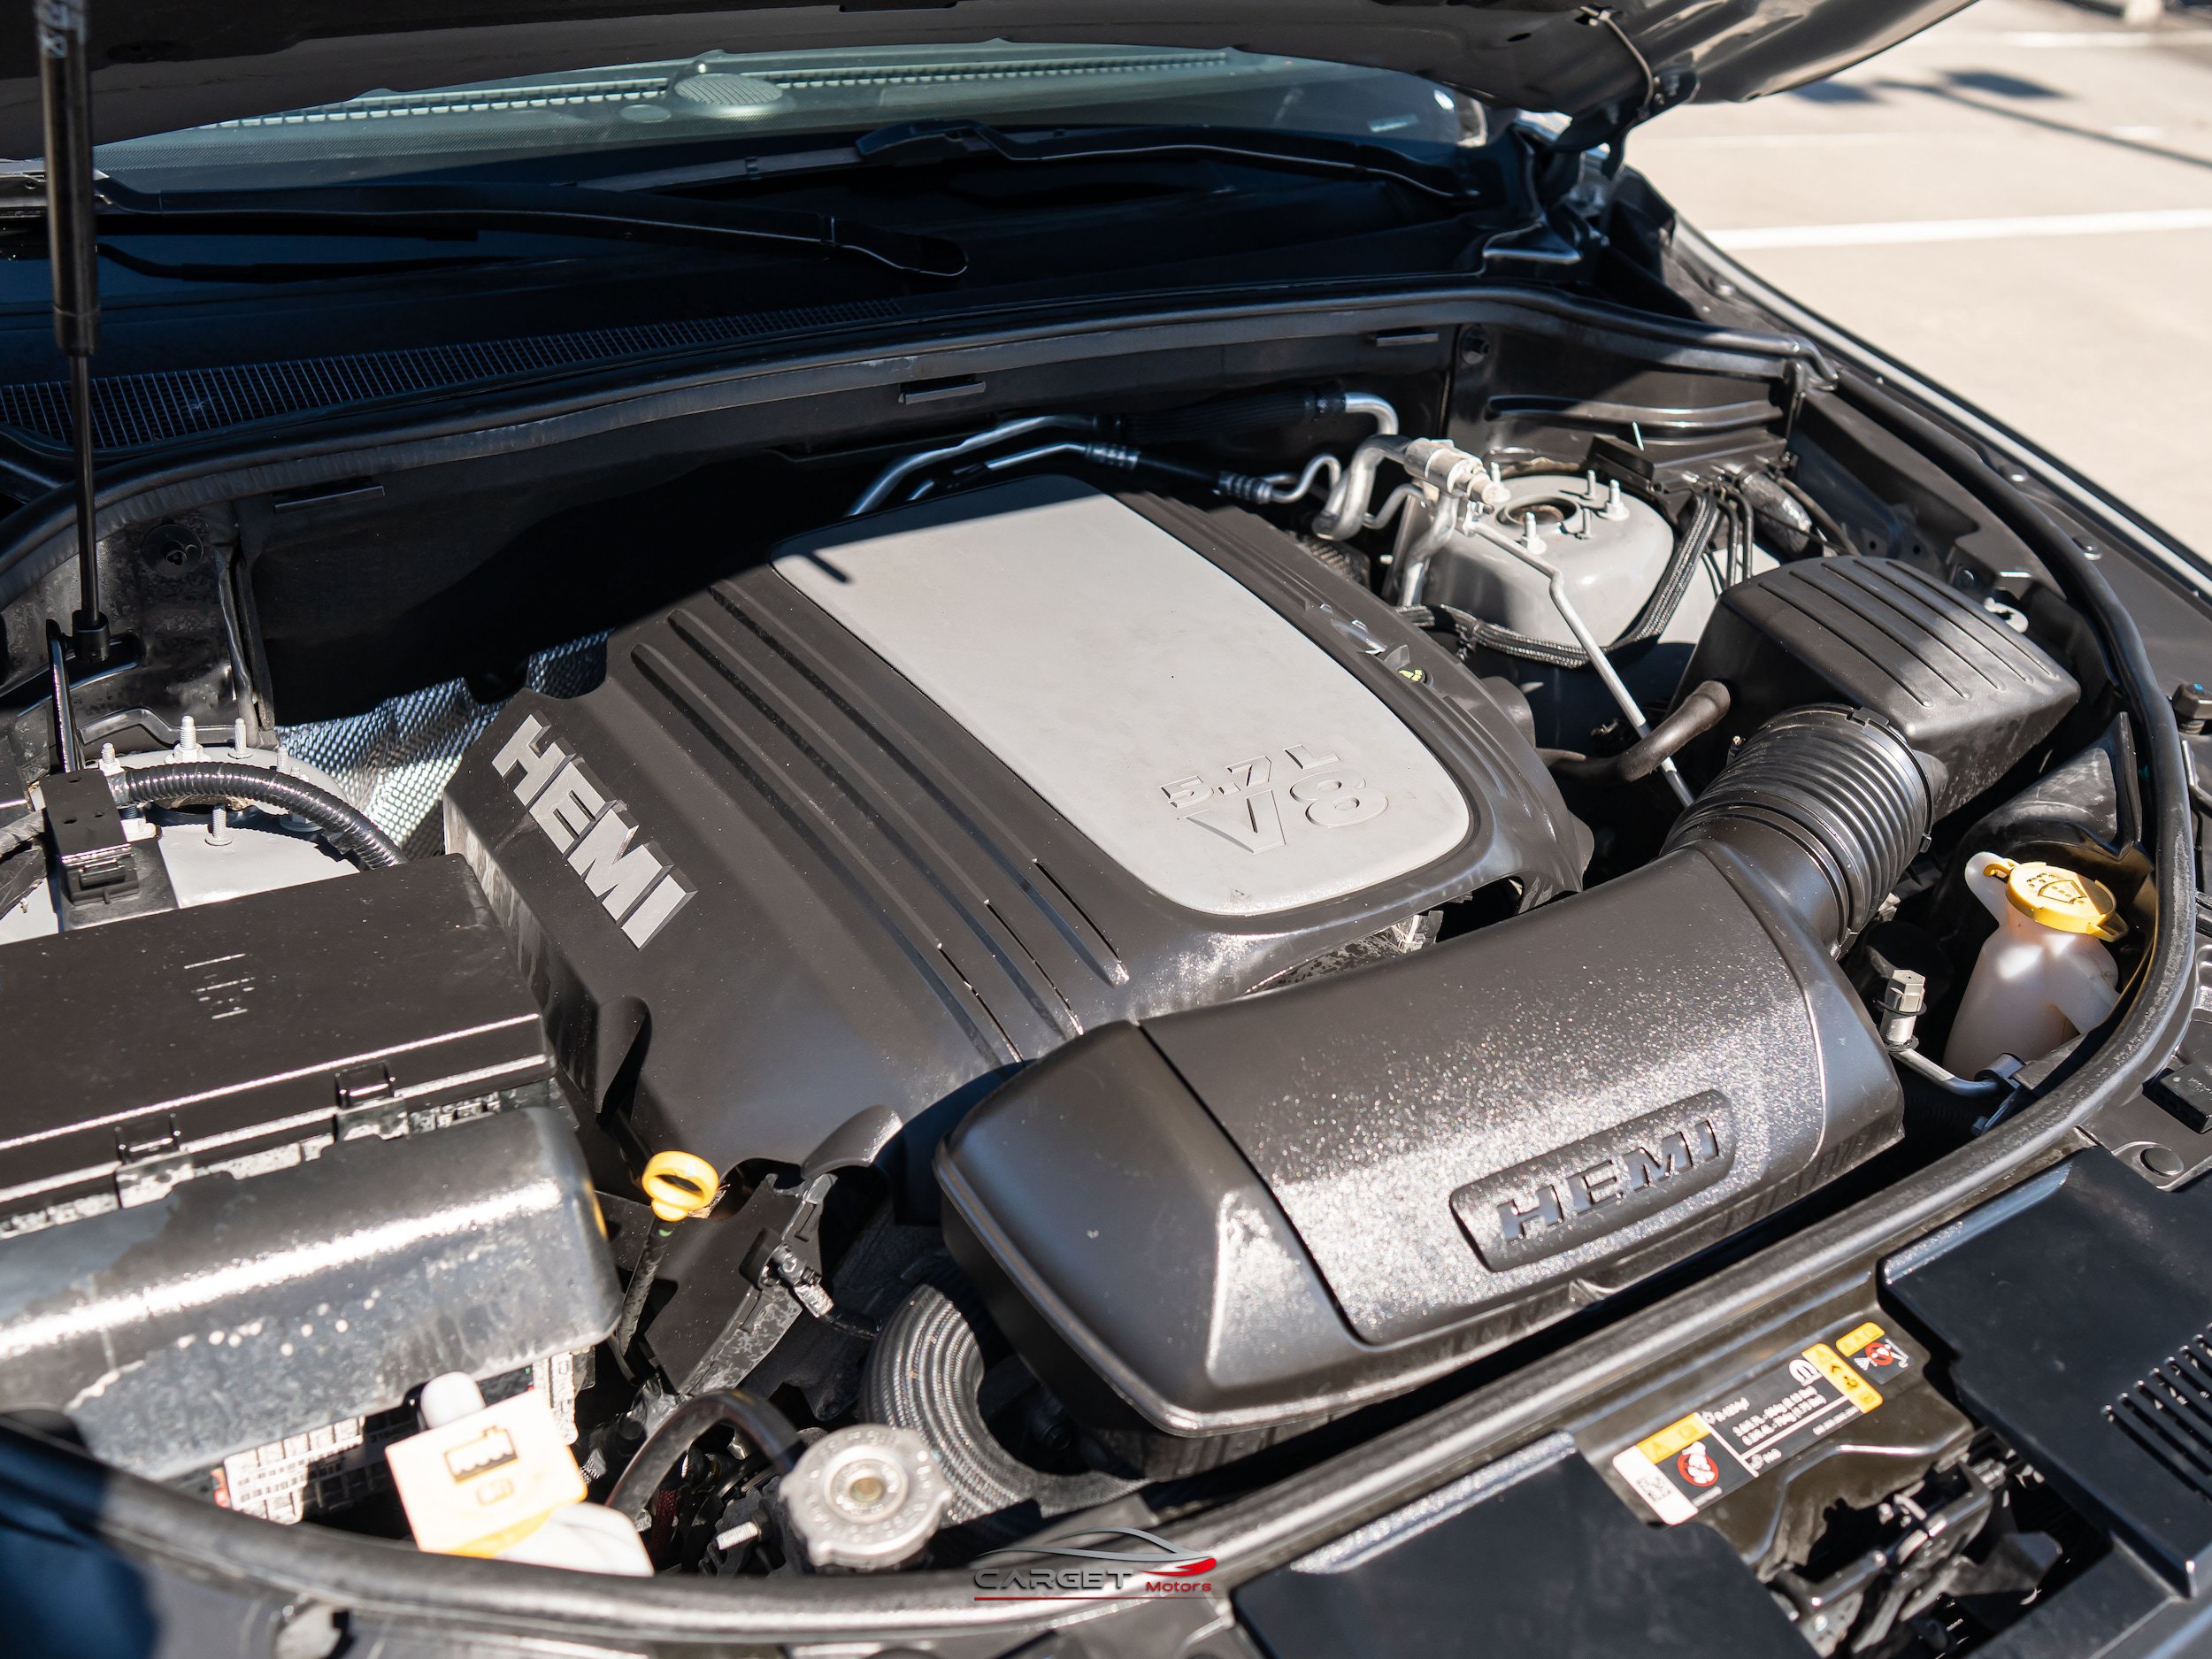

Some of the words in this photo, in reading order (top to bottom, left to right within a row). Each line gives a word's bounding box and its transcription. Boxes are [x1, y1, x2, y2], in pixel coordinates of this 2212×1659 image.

[491, 712, 694, 952] HEMI
[1179, 770, 1390, 855] V8
[1496, 1118, 1719, 1243] HEMI
